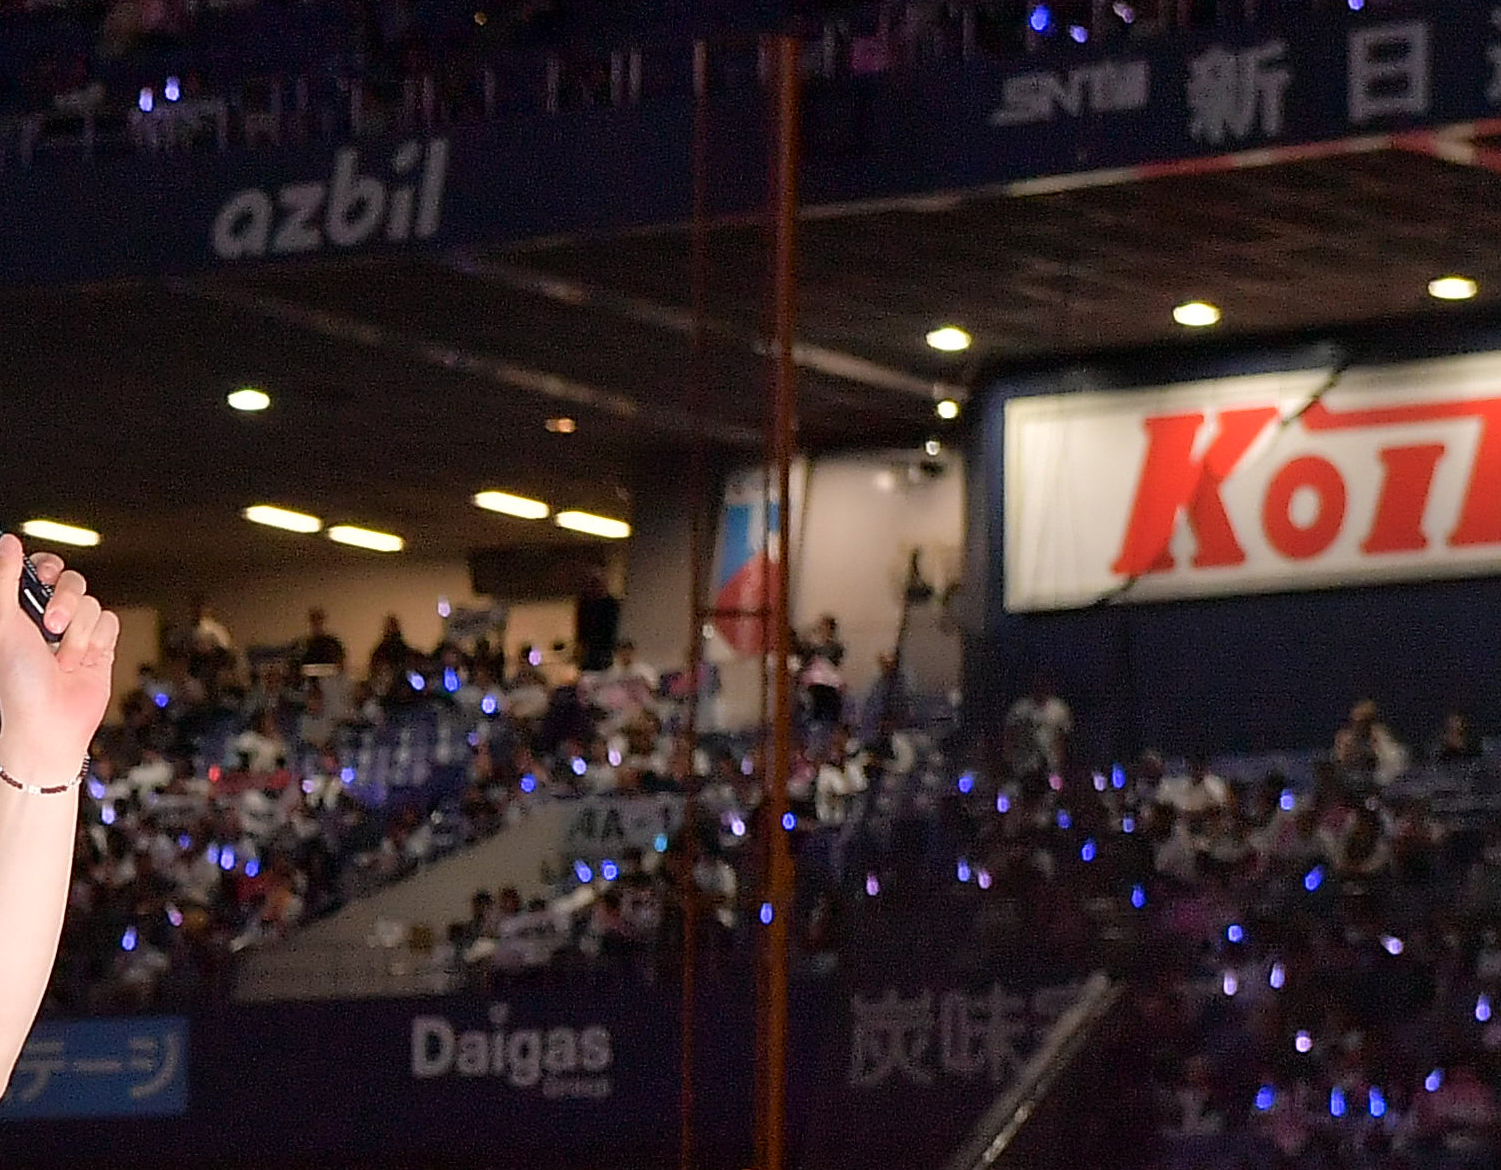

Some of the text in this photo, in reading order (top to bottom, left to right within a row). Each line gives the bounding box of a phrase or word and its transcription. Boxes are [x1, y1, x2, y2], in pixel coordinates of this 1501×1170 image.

[1187, 12, 1501, 146] 新日
[215, 138, 445, 259] azbil
[411, 1001, 614, 1085] Daigas
